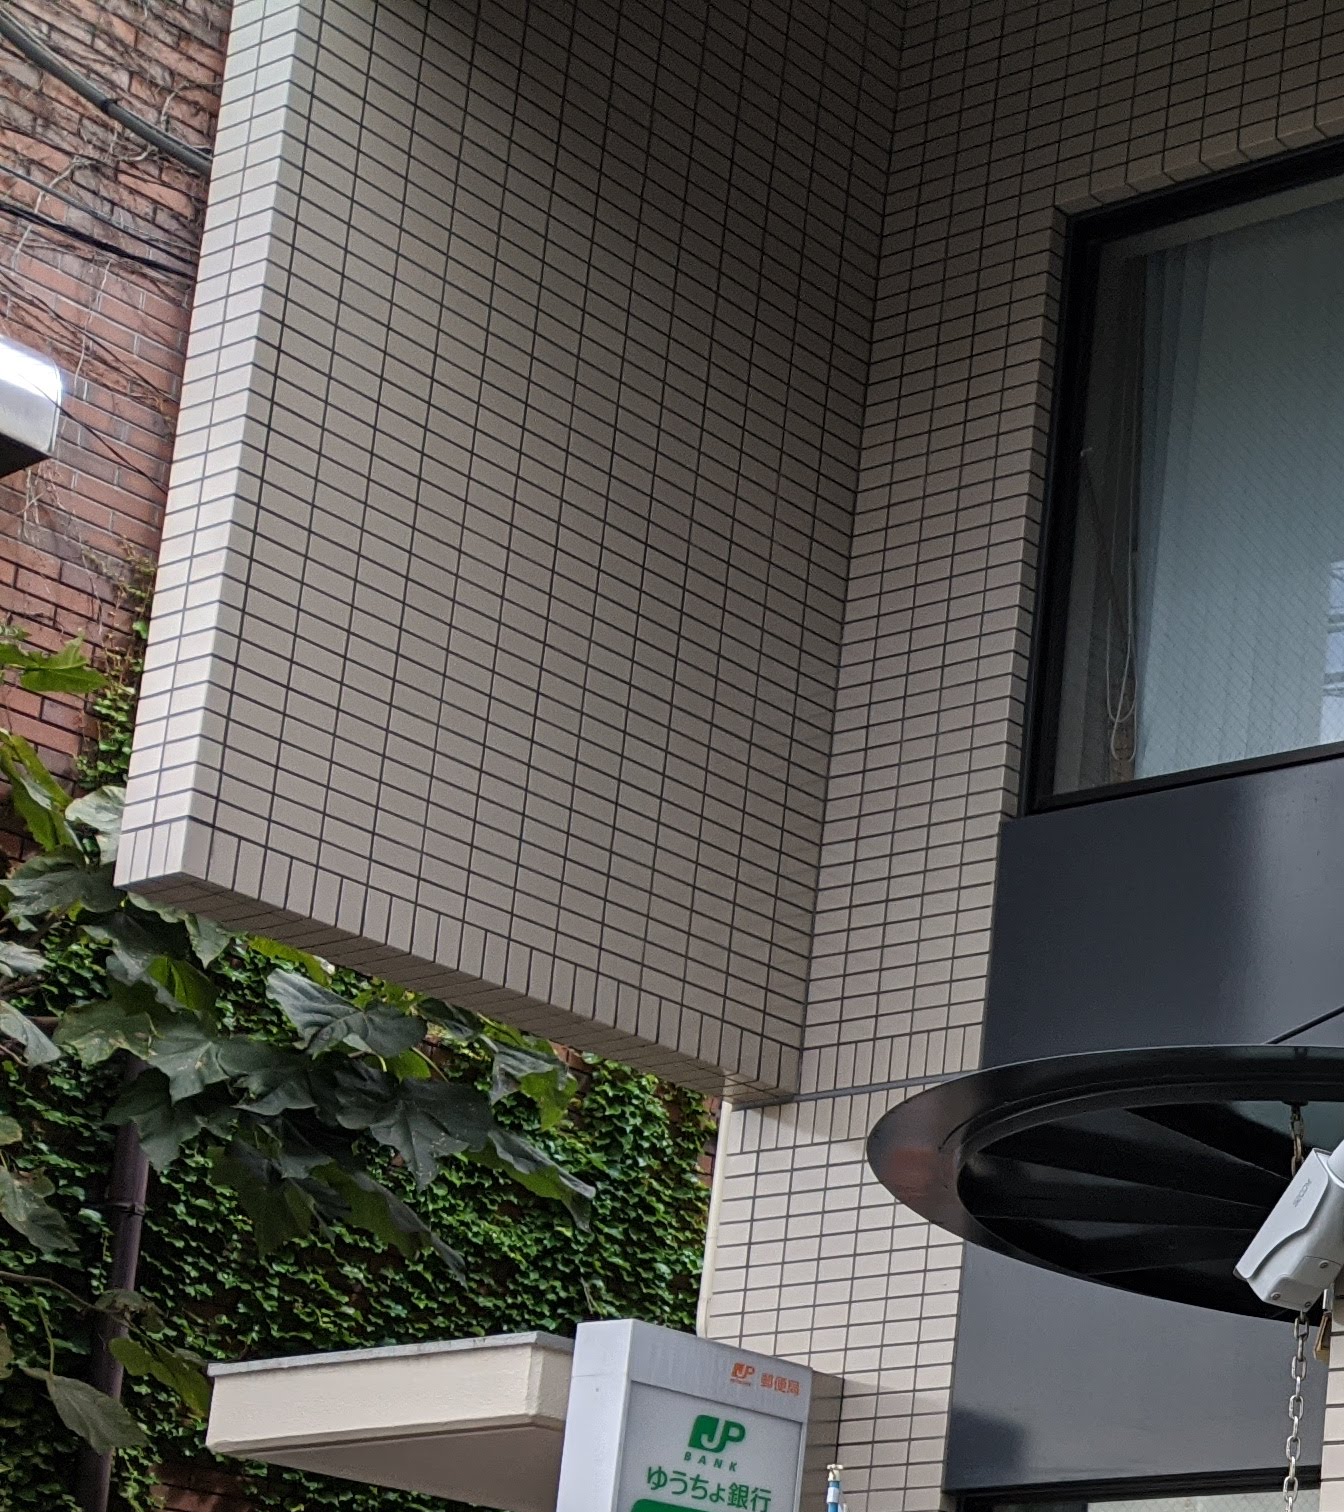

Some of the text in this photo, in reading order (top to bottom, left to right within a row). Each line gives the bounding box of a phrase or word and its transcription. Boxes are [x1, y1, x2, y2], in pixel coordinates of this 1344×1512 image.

[760, 1371, 800, 1395] 郵便局
[684, 1452, 738, 1472] BANK
